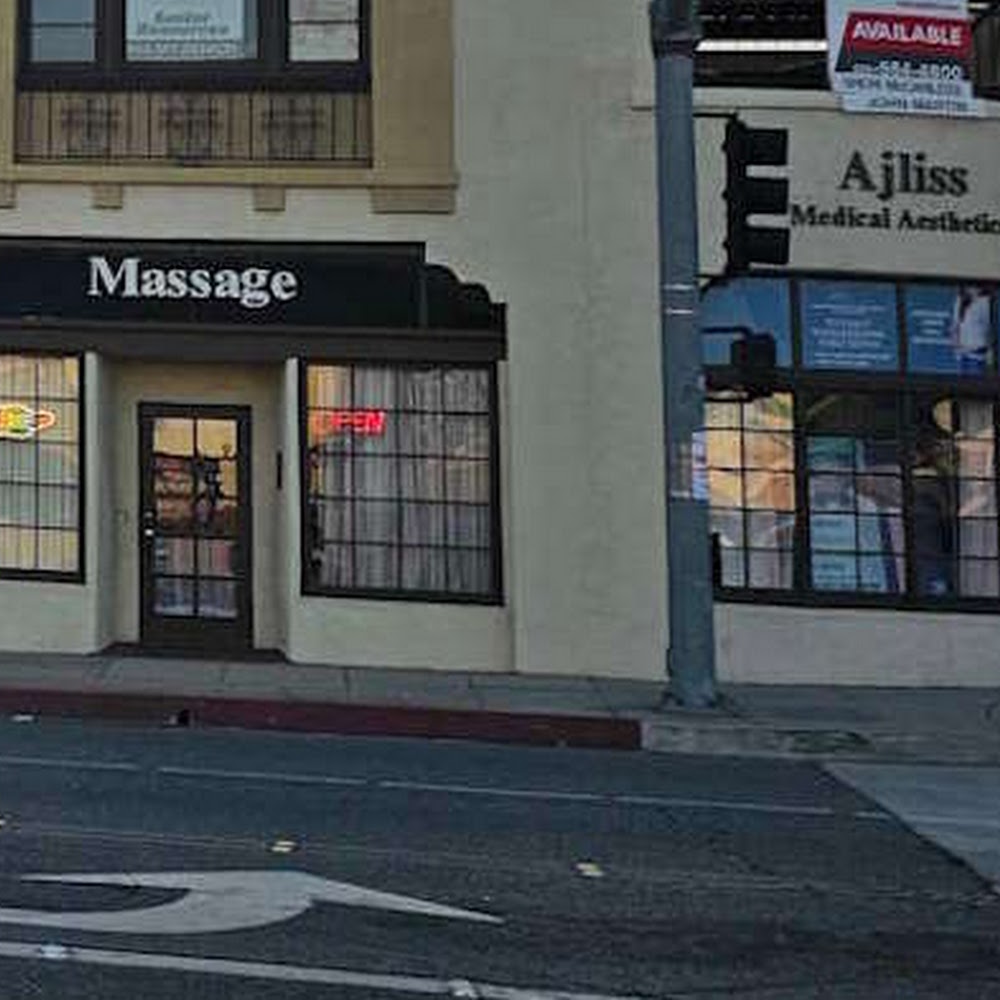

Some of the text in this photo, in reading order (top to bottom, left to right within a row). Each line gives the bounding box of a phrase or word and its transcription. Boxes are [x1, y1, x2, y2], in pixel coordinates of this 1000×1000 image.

[852, 20, 962, 46] AVAILABLE
[837, 150, 969, 200] Ajliss
[791, 204, 891, 229] Medical
[87, 256, 298, 309] Massage
